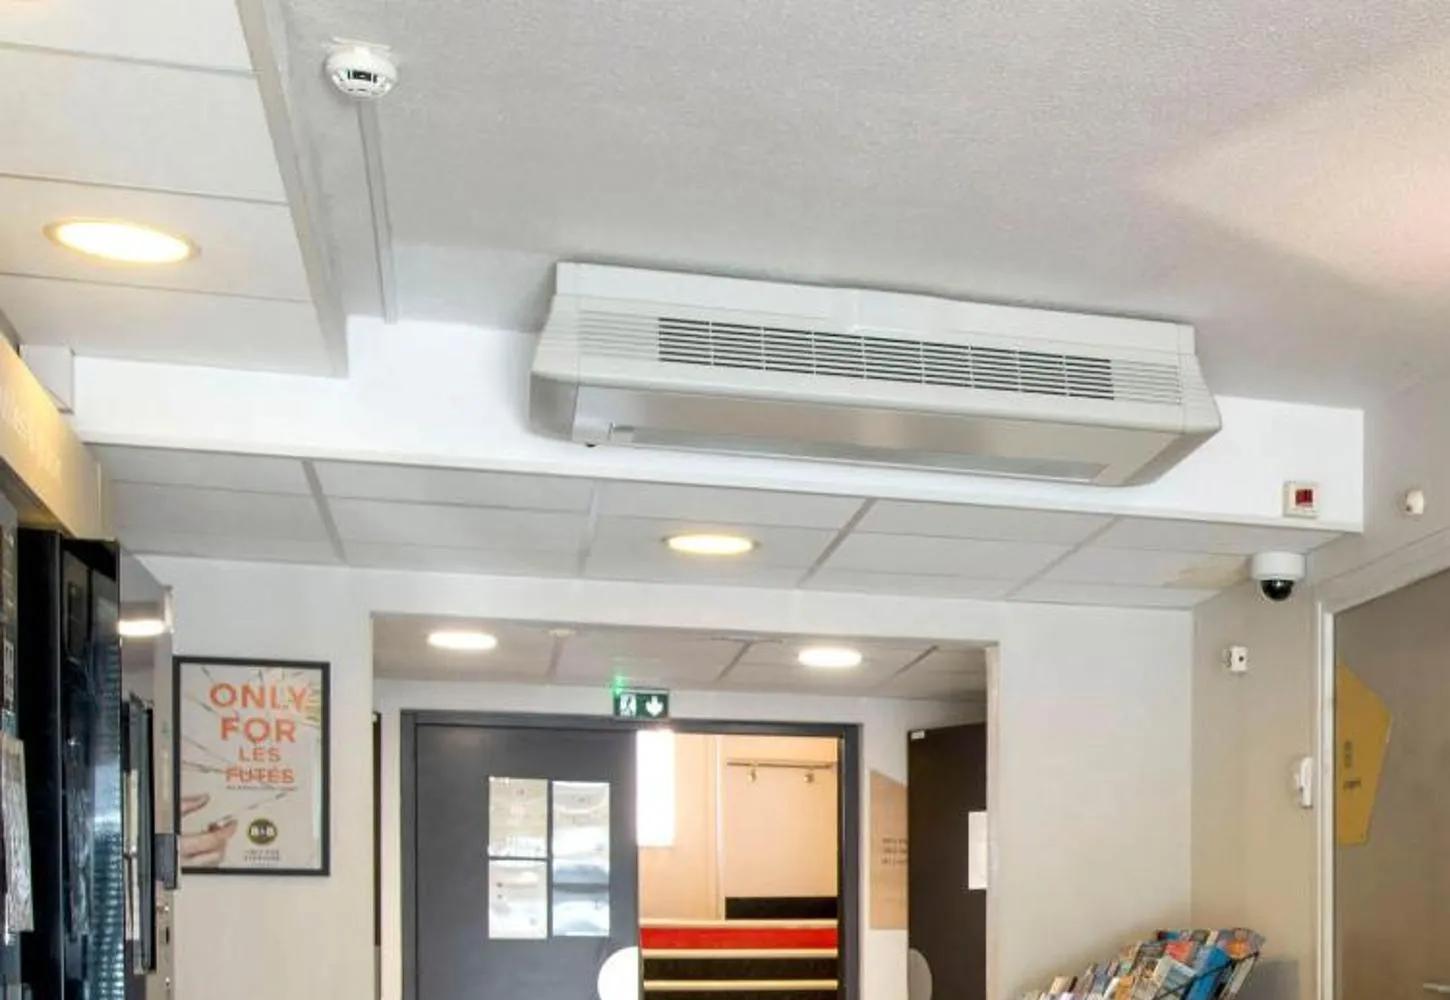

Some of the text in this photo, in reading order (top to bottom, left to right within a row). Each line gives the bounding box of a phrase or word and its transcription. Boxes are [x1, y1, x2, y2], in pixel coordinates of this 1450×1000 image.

[209, 682, 308, 712] ONLY
[220, 714, 296, 743] FOR
[239, 746, 281, 763] LES
